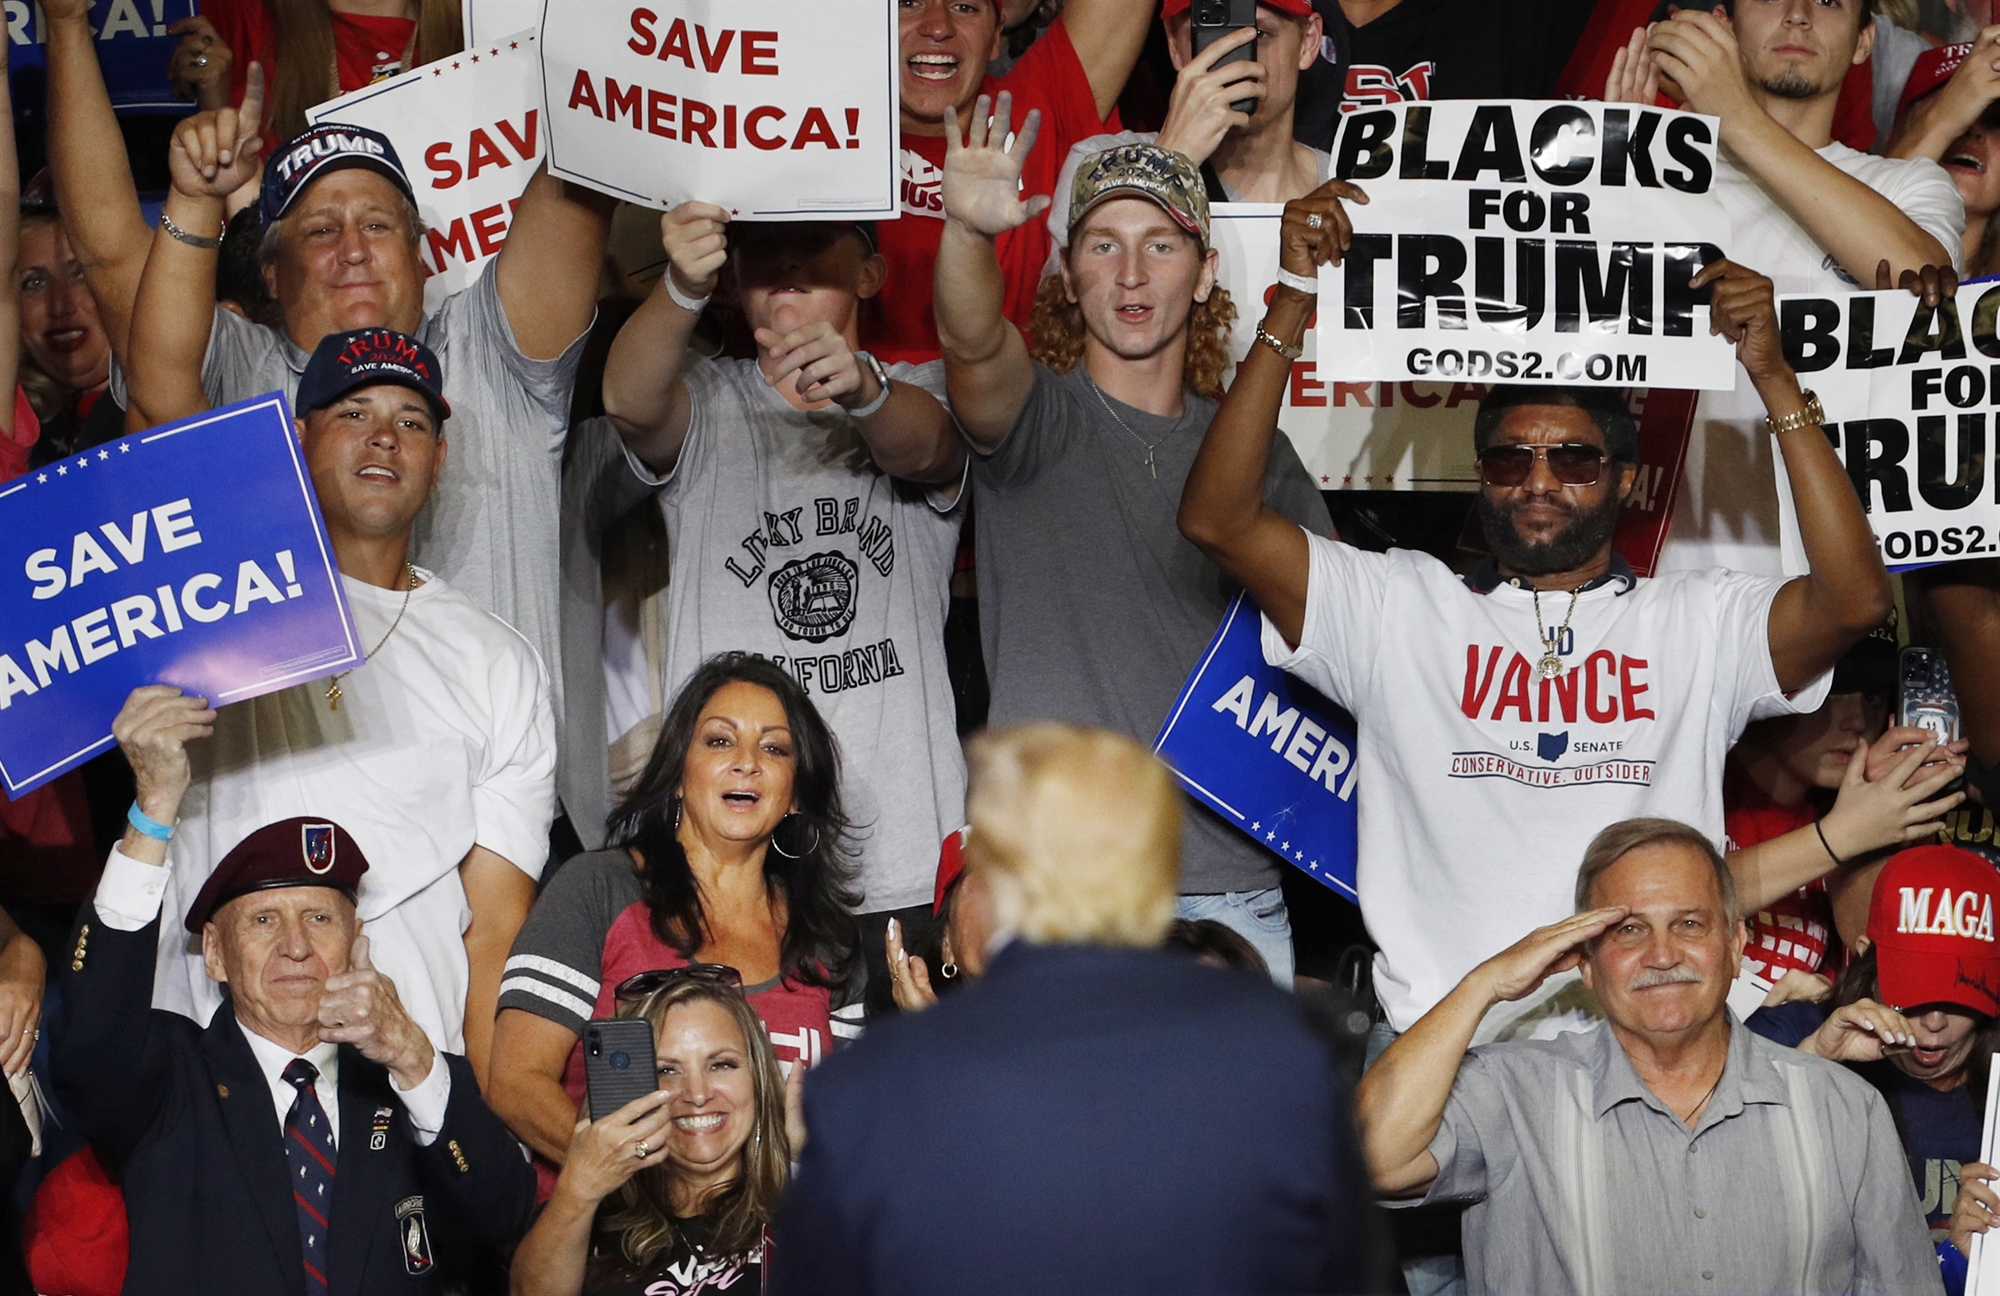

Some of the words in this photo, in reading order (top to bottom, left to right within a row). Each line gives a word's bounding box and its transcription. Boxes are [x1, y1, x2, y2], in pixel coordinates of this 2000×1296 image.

[627, 7, 779, 76] SAVE
[568, 69, 860, 151] AMERICA!
[276, 133, 385, 181] TRUMP
[1087, 148, 1188, 196] TRUMP
[1336, 105, 1713, 194] BLACKS
[1099, 179, 1123, 191] SAVE
[1469, 188, 1591, 234] FOR
[1340, 232, 1727, 338] TRUMP
[336, 332, 431, 379] TRUMP
[351, 362, 377, 375] SAVE
[1406, 348, 1647, 382] GODS2.COM
[1911, 365, 2000, 411] FO
[1820, 412, 2000, 514] RU
[24, 497, 202, 600] SAVE
[725, 507, 803, 588] LUKY
[814, 497, 895, 577] BRND
[1876, 525, 2000, 560] ODS2.
[0, 549, 303, 711] AMERICA!
[1461, 644, 1655, 724] VANCE
[1451, 756, 1567, 784] CONSERVATIVE.
[1574, 763, 1651, 782] OUTSIDER.
[1509, 740, 1533, 751] U.S.
[1574, 740, 1624, 752] SENATE
[1896, 886, 1995, 942] MAGA
